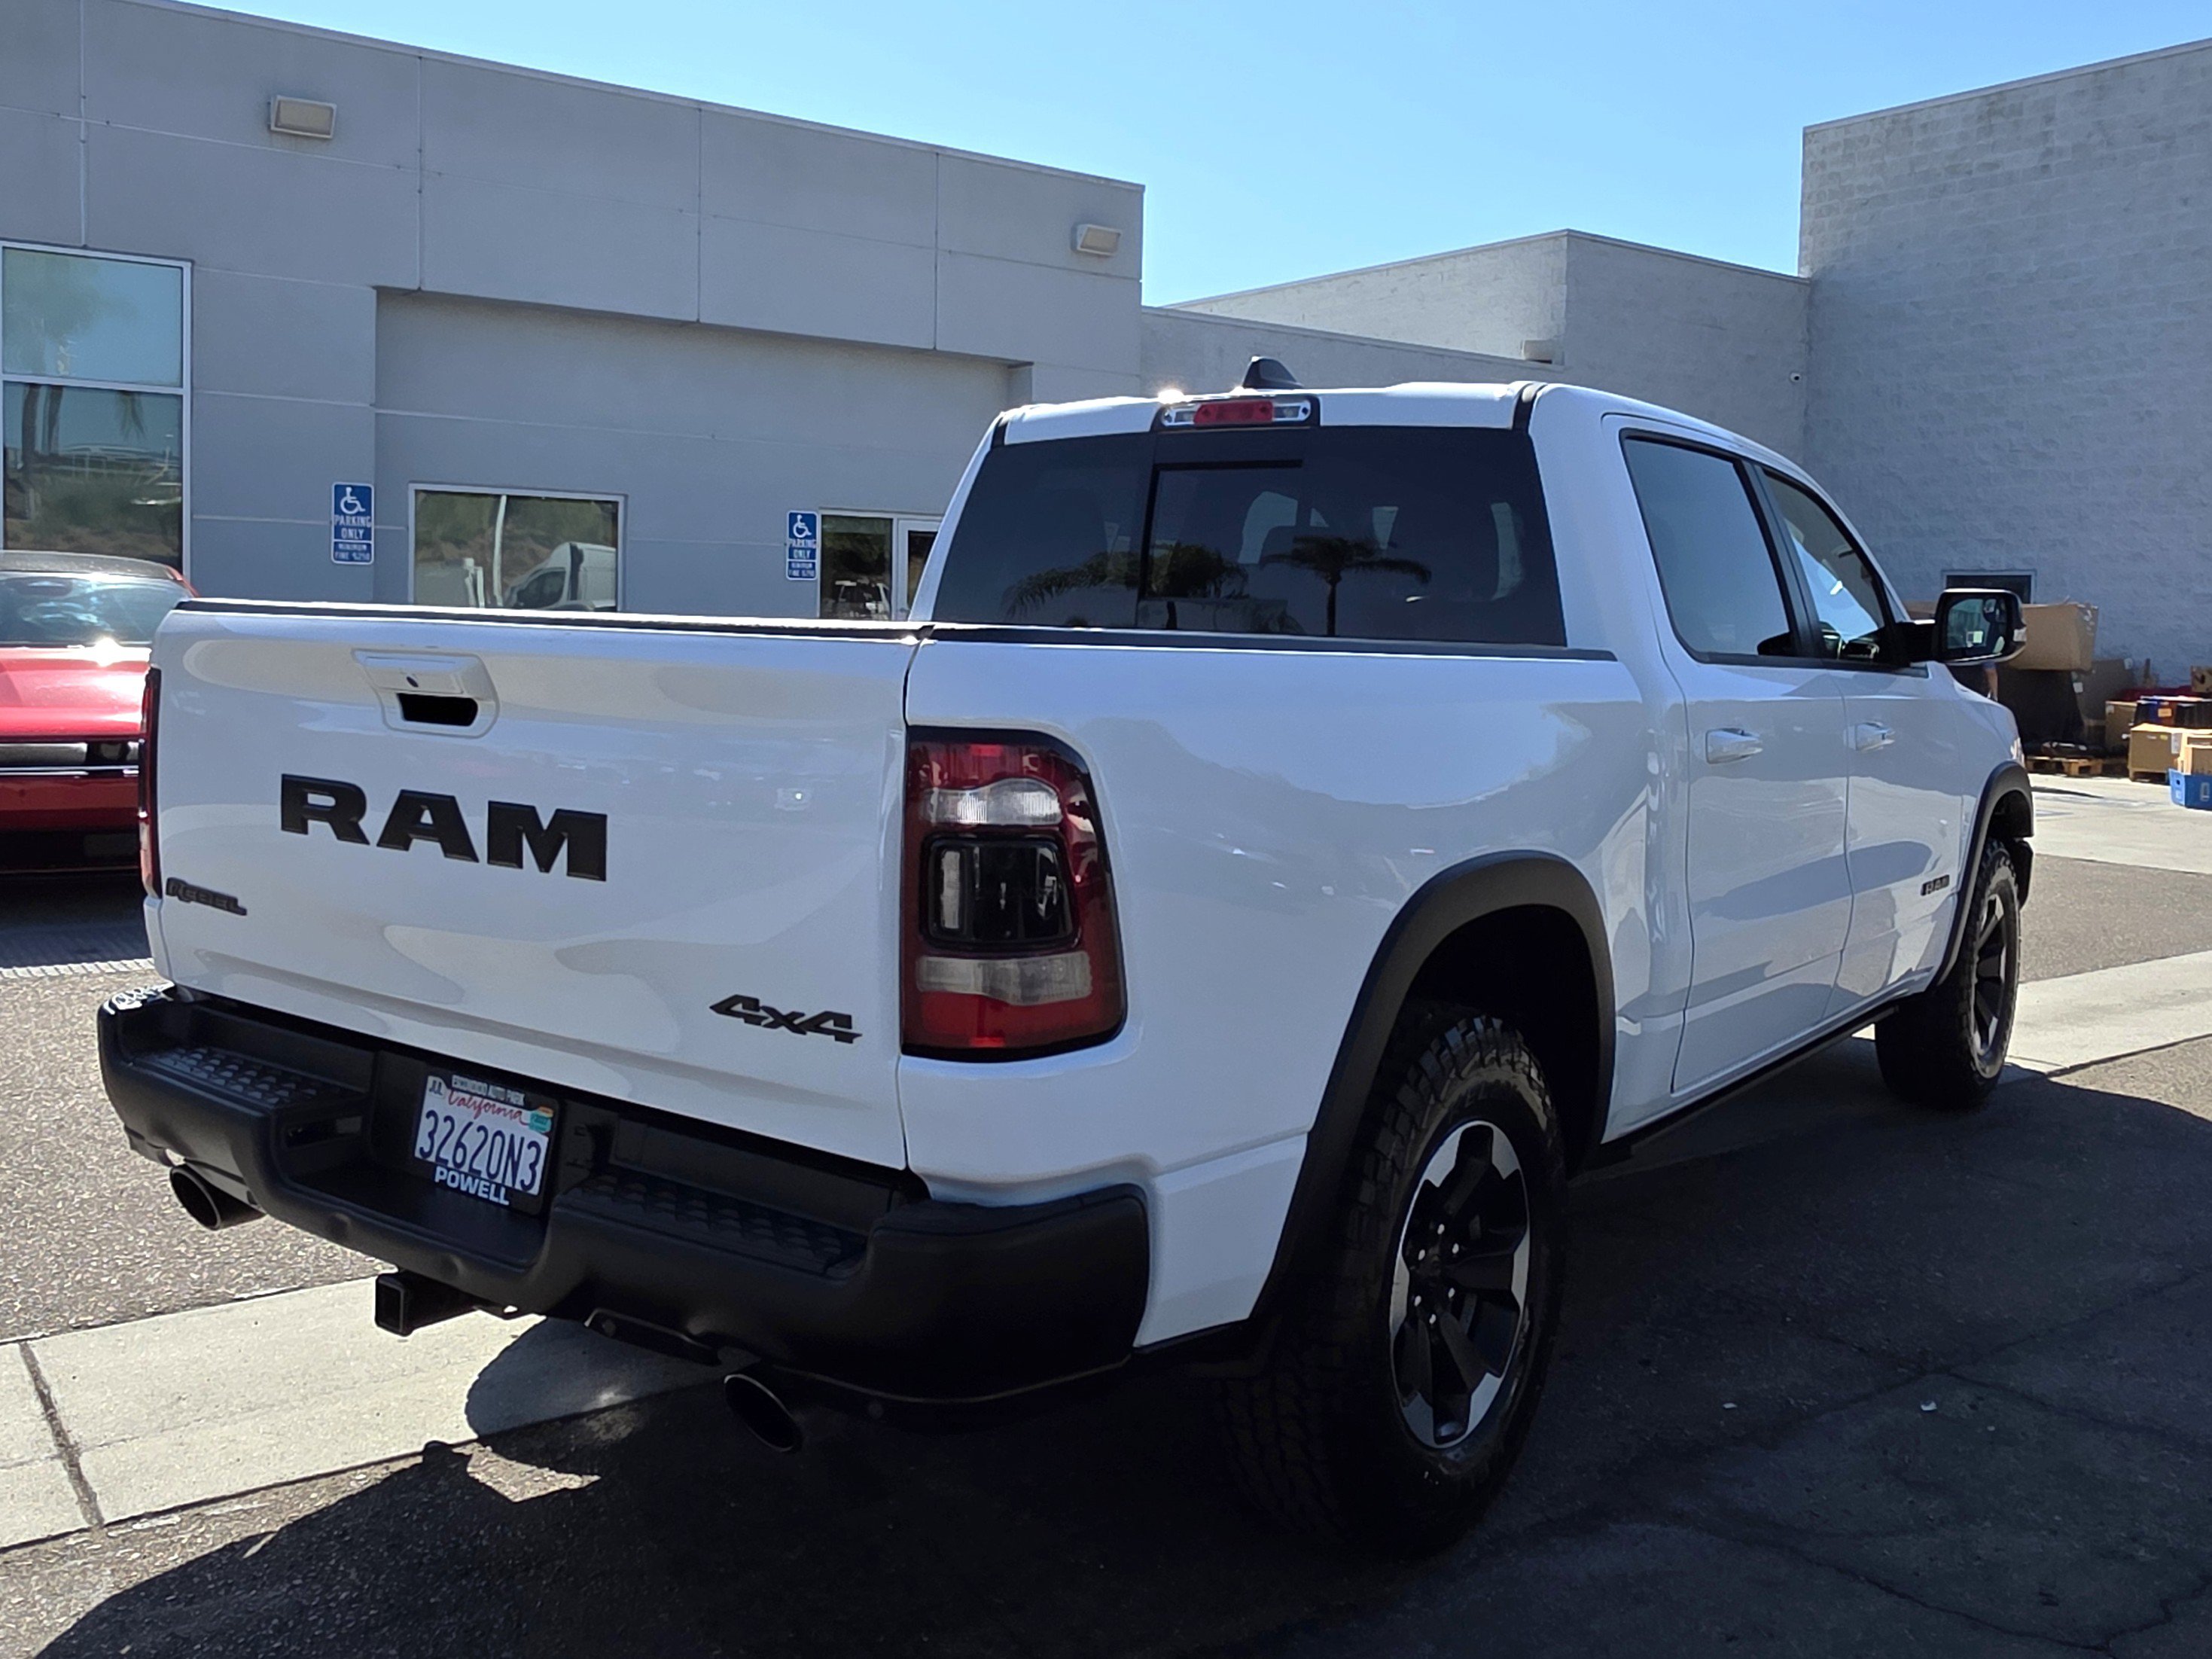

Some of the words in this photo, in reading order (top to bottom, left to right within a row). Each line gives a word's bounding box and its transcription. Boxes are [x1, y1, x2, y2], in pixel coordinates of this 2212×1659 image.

[334, 514, 371, 527] PARKING
[341, 527, 364, 539] ONLY
[281, 773, 607, 882] RAM
[1920, 874, 1950, 896] RAM
[448, 1090, 529, 1126] California
[419, 1110, 541, 1191] 32620N3
[434, 1166, 509, 1206] POWELL
